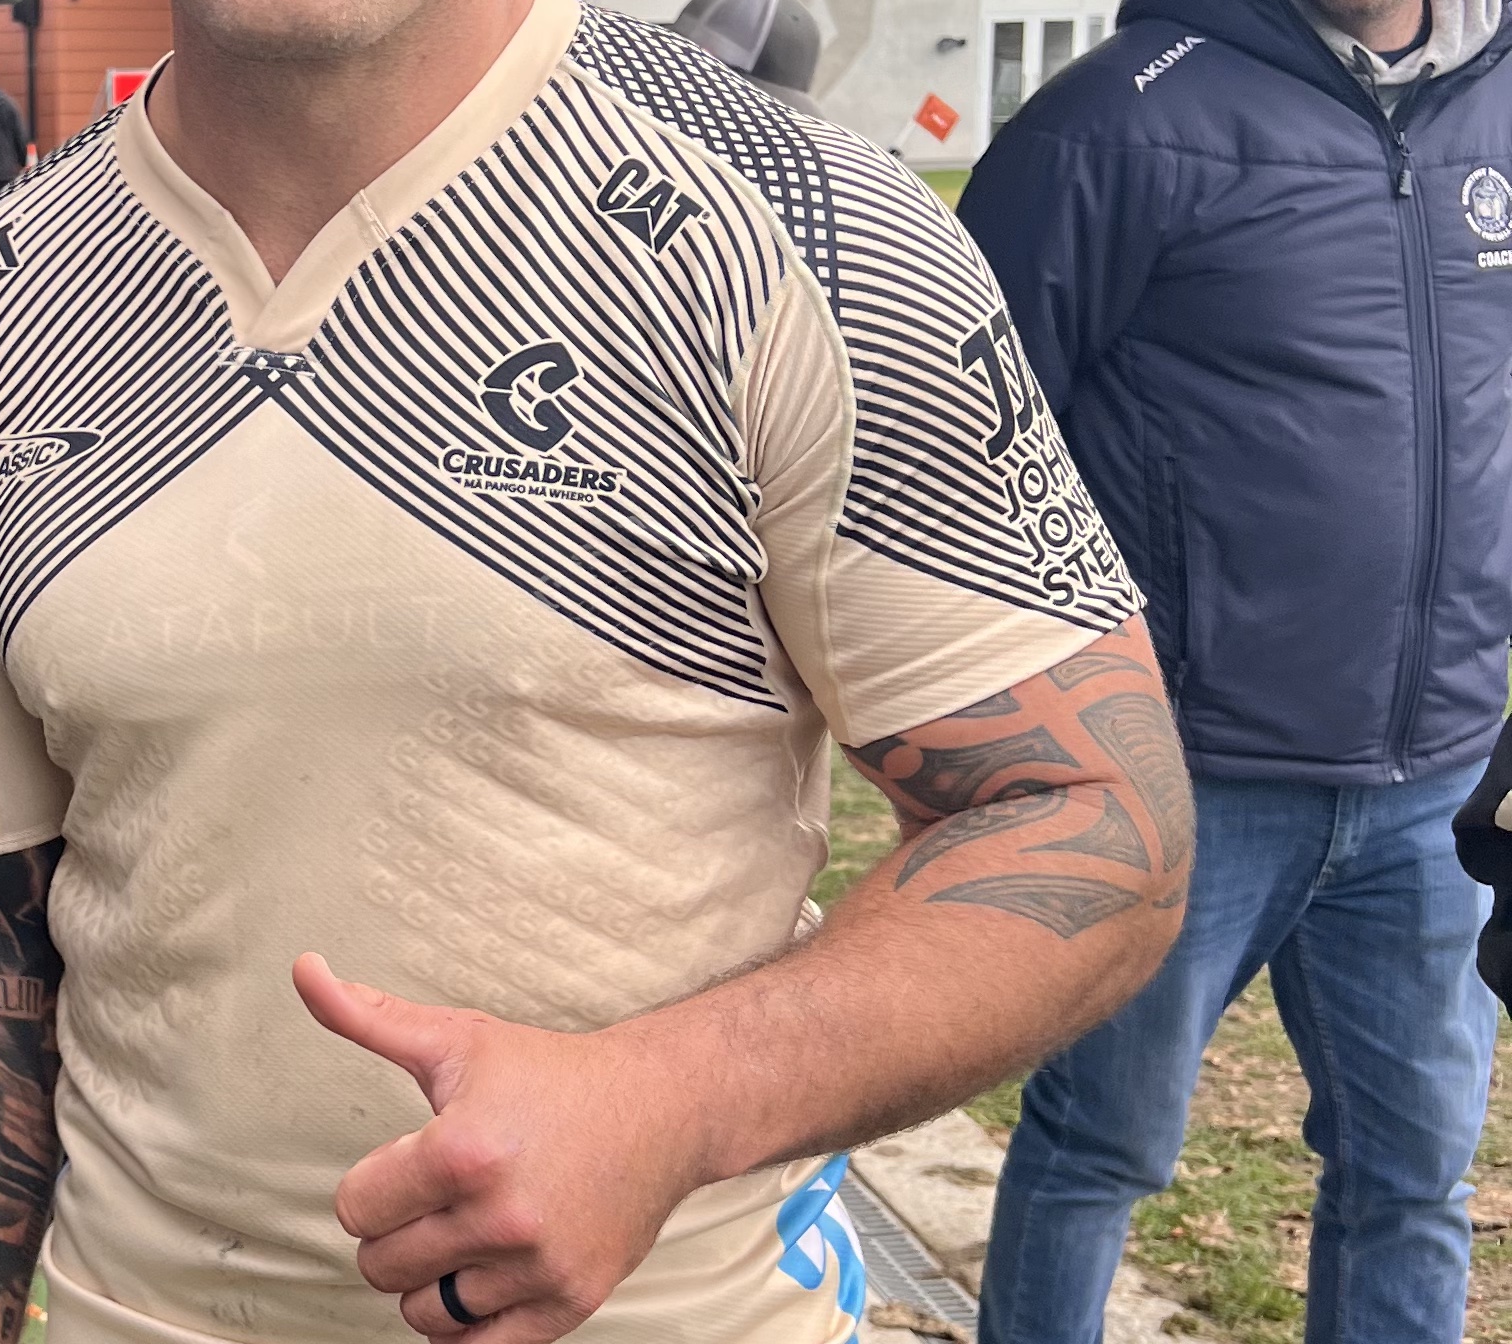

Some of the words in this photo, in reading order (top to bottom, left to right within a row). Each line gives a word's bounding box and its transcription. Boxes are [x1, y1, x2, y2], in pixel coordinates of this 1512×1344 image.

[1134, 36, 1206, 93] AKUMA
[596, 158, 704, 255] CAT
[442, 448, 618, 493] CRUSADERS
[485, 480, 526, 494] PANGO
[549, 487, 595, 504] WHERO
[1022, 478, 1097, 567] JONE
[1042, 522, 1121, 606] STEE
[58, 594, 455, 663] ATAPULT
